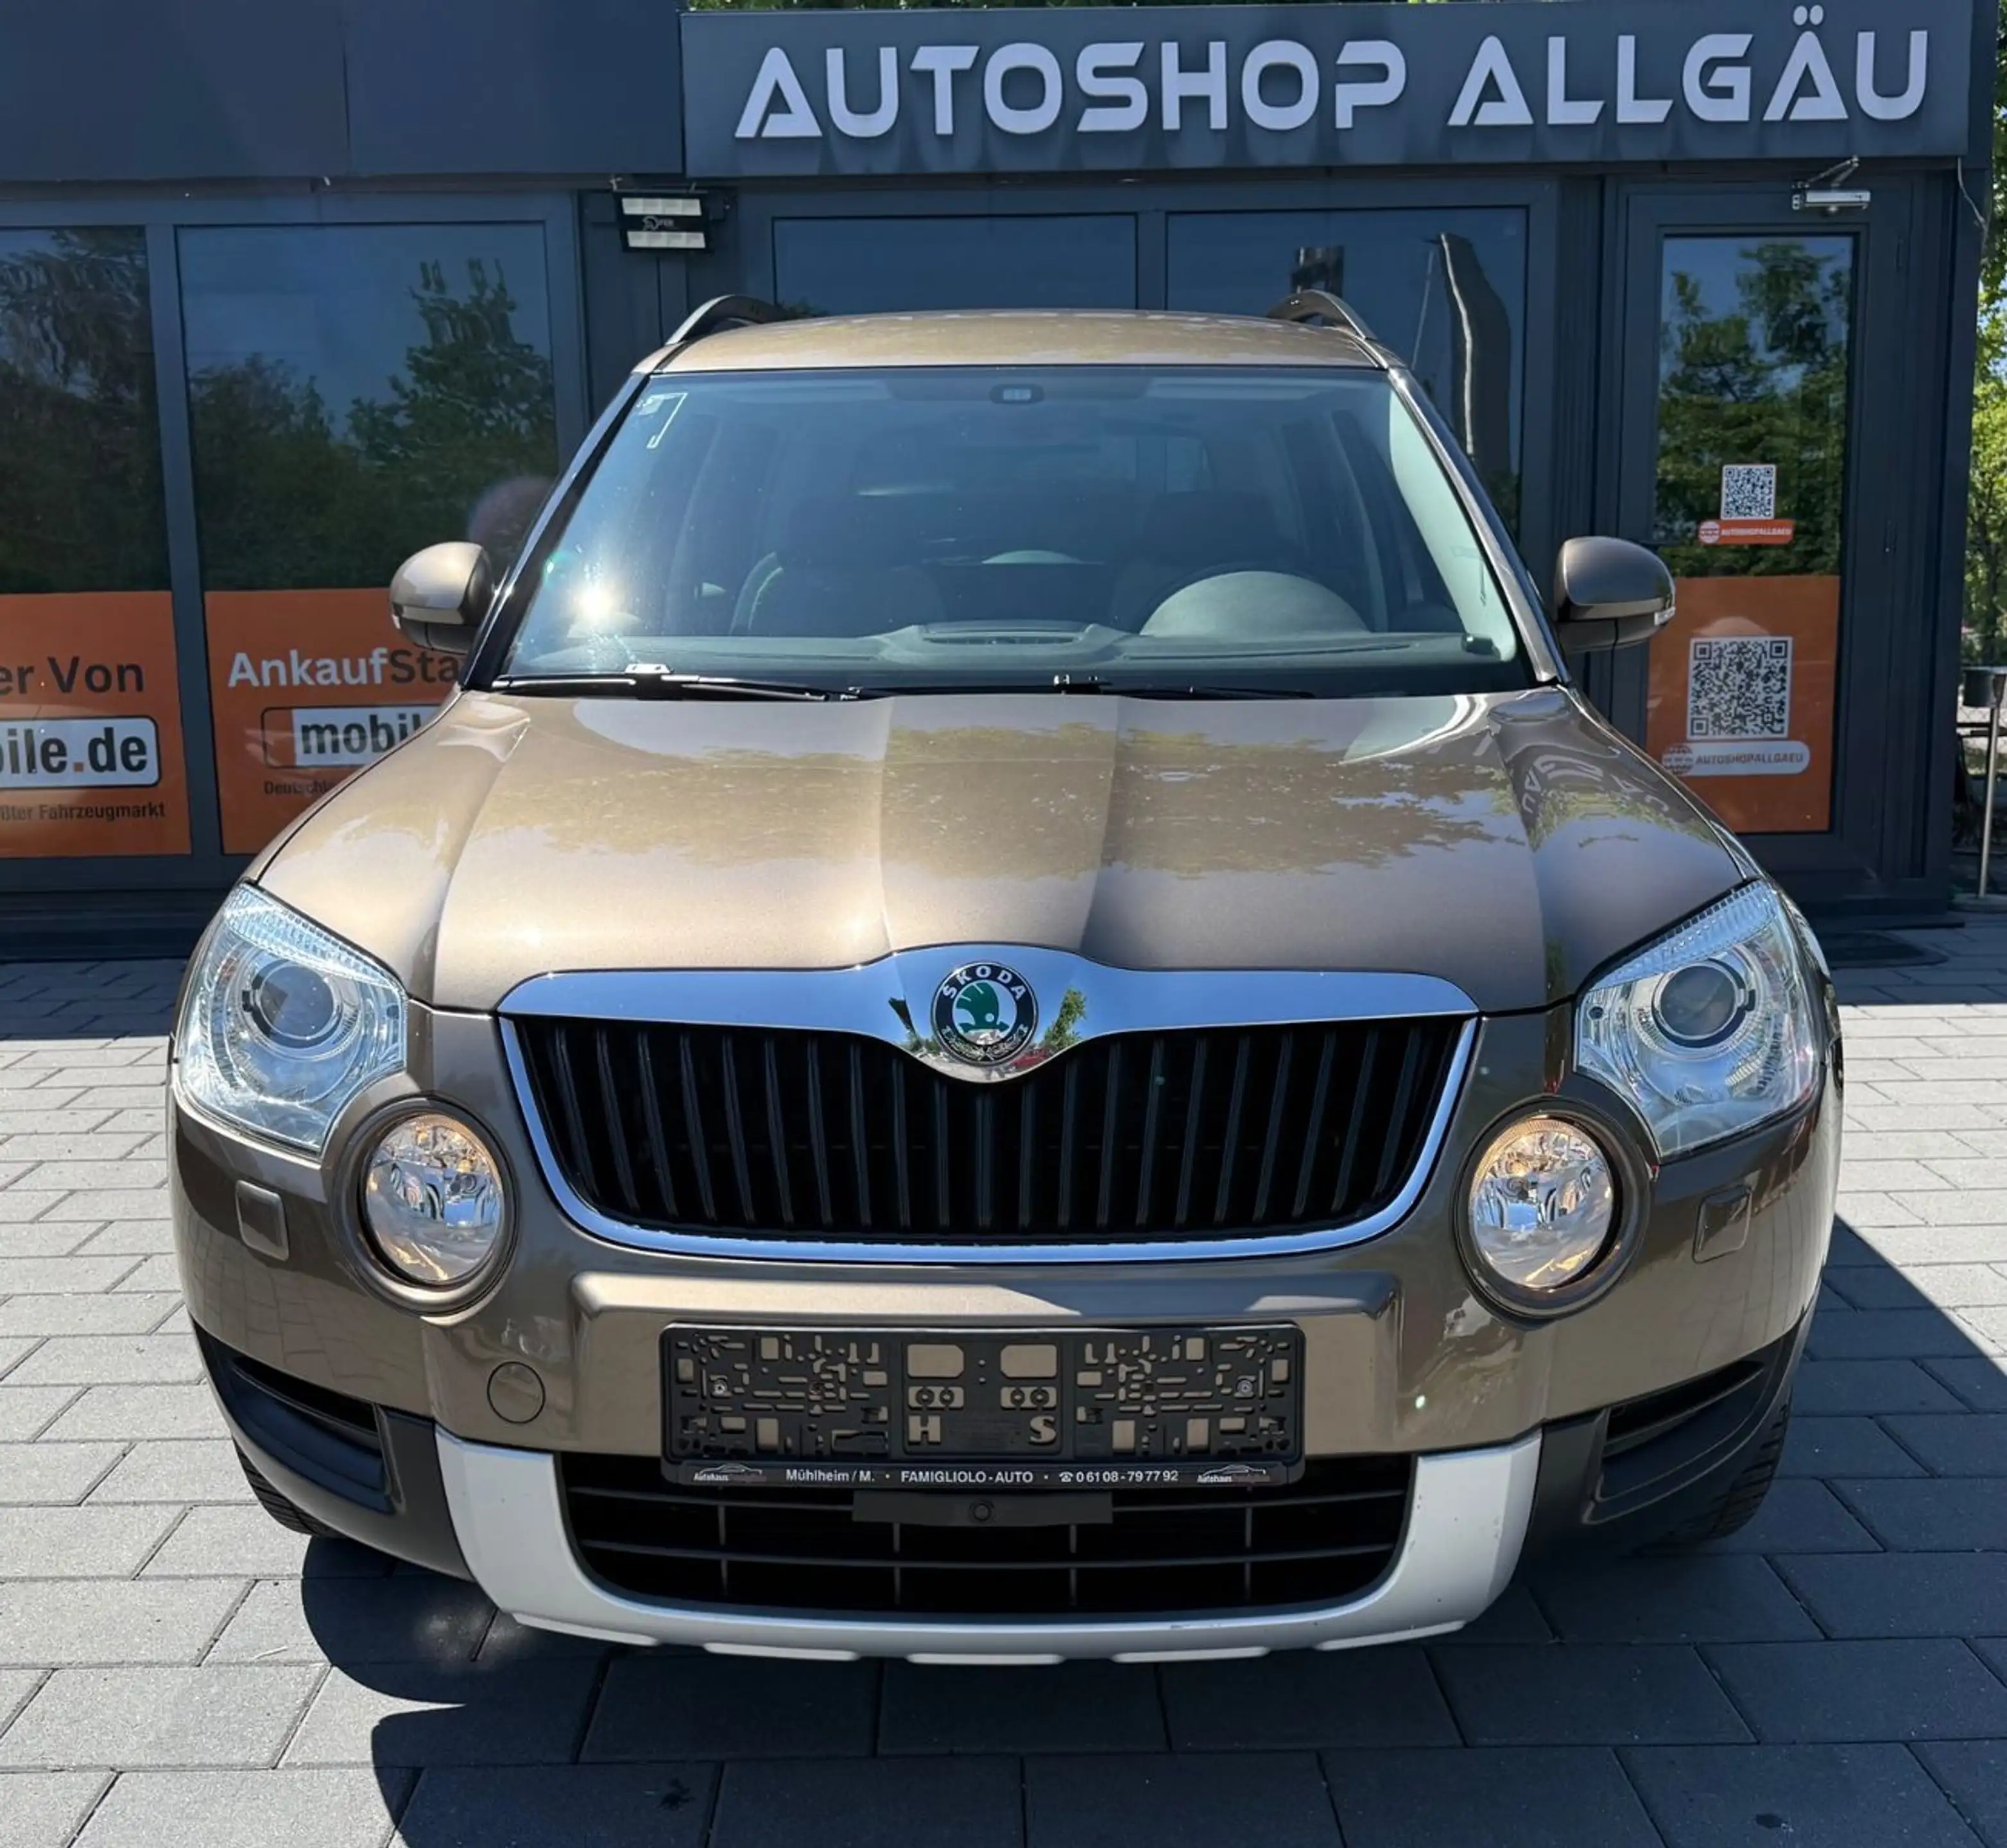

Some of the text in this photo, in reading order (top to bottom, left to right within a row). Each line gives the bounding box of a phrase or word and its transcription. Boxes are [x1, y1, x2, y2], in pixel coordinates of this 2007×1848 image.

[735, 4, 1927, 138] AUTOSHOP ALLGÄU
[47, 656, 144, 693] Von
[0, 727, 148, 774] ile.de
[1695, 751, 1804, 765] AUTOSHOPALLGAEU
[39, 801, 166, 821] Fahrzeugmarkt
[786, 1468, 849, 1482] Mühlheim
